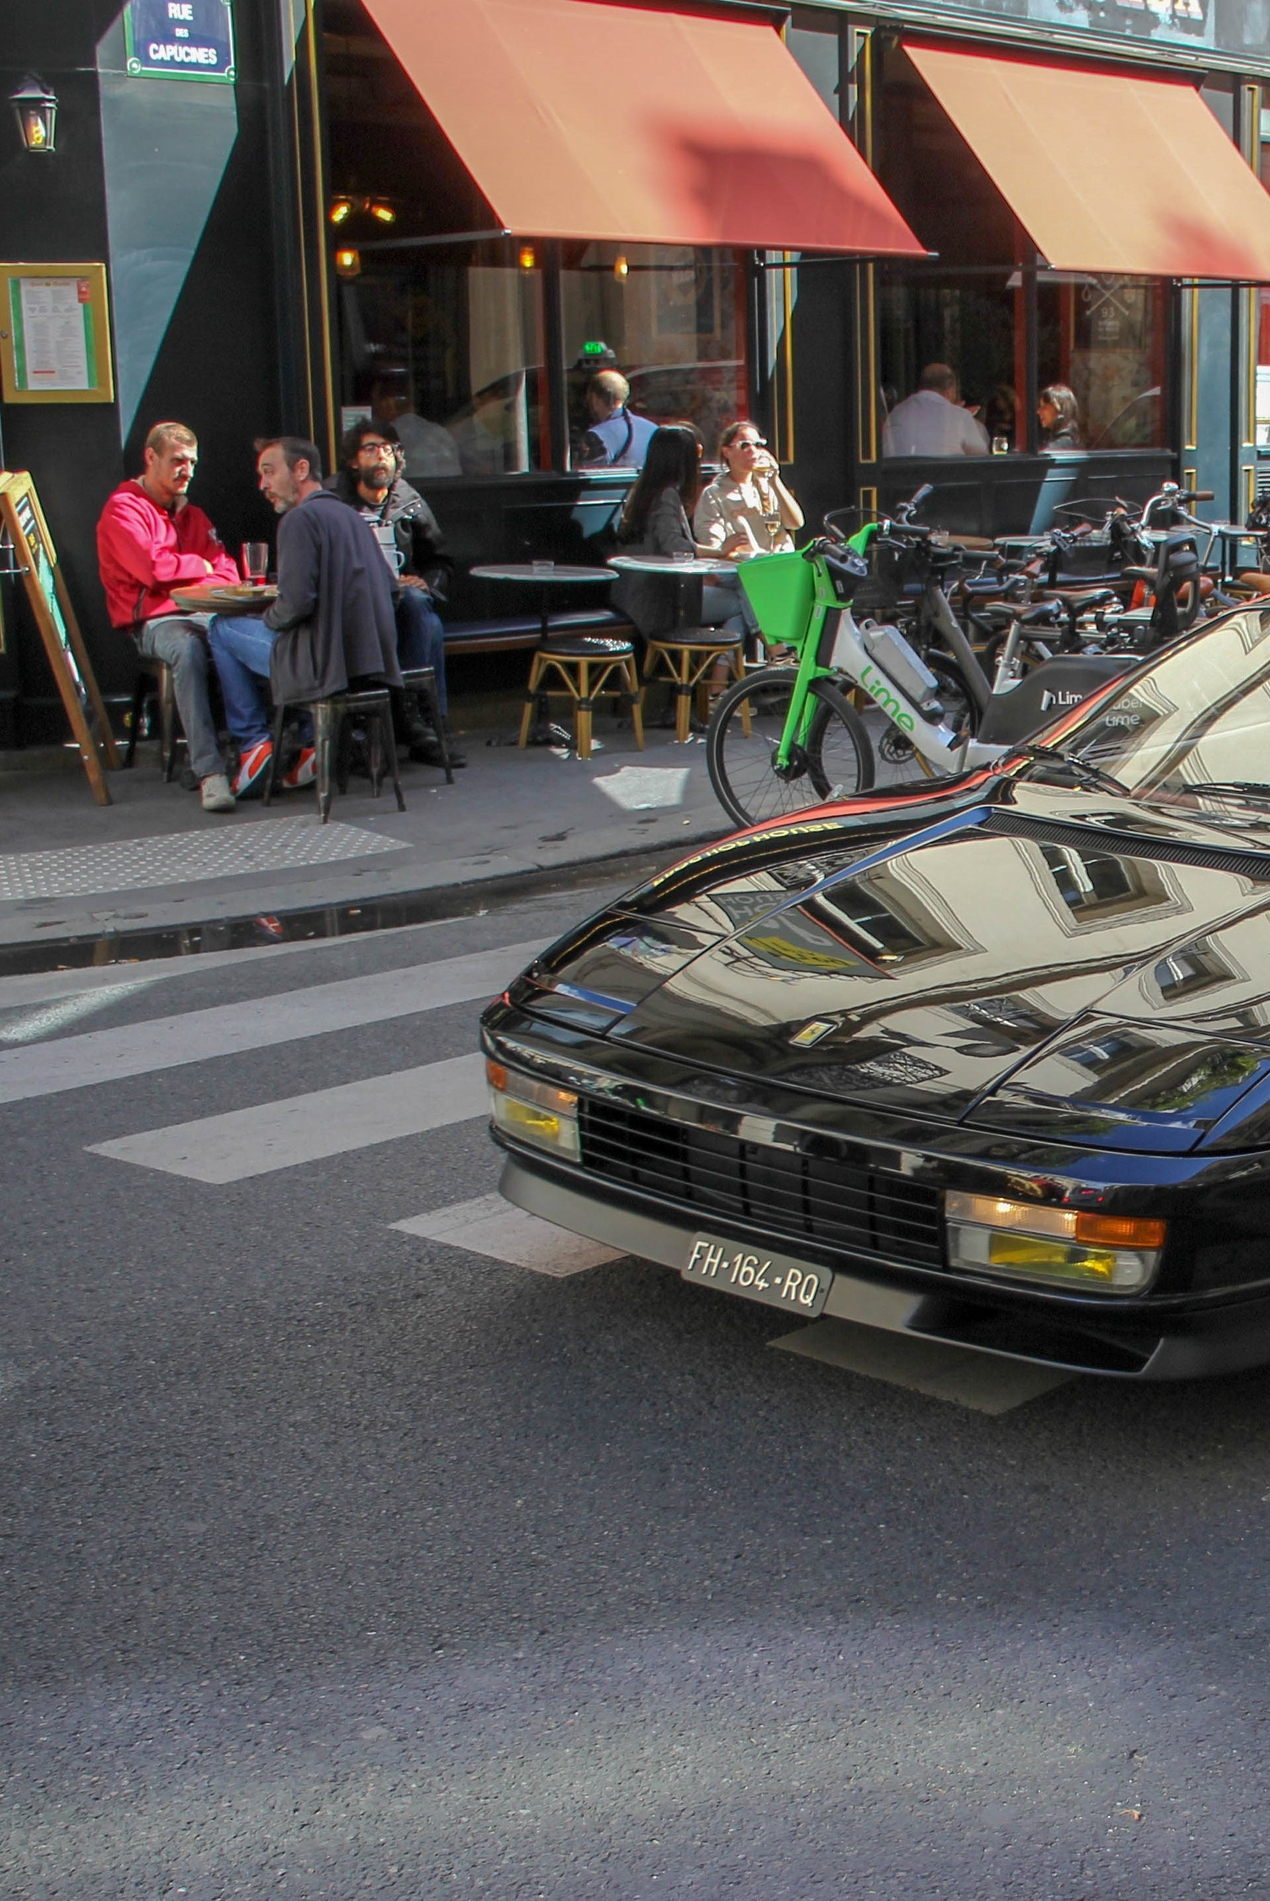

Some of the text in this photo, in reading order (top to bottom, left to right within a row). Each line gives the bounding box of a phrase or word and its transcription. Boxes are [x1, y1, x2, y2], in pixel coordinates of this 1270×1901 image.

[168, 3, 193, 20] RUE
[175, 28, 189, 38] DES
[149, 43, 218, 65] CAPUCINES
[861, 665, 915, 733] Lime
[1058, 691, 1083, 705] Lim
[688, 1240, 820, 1308] FH-164-RQ
